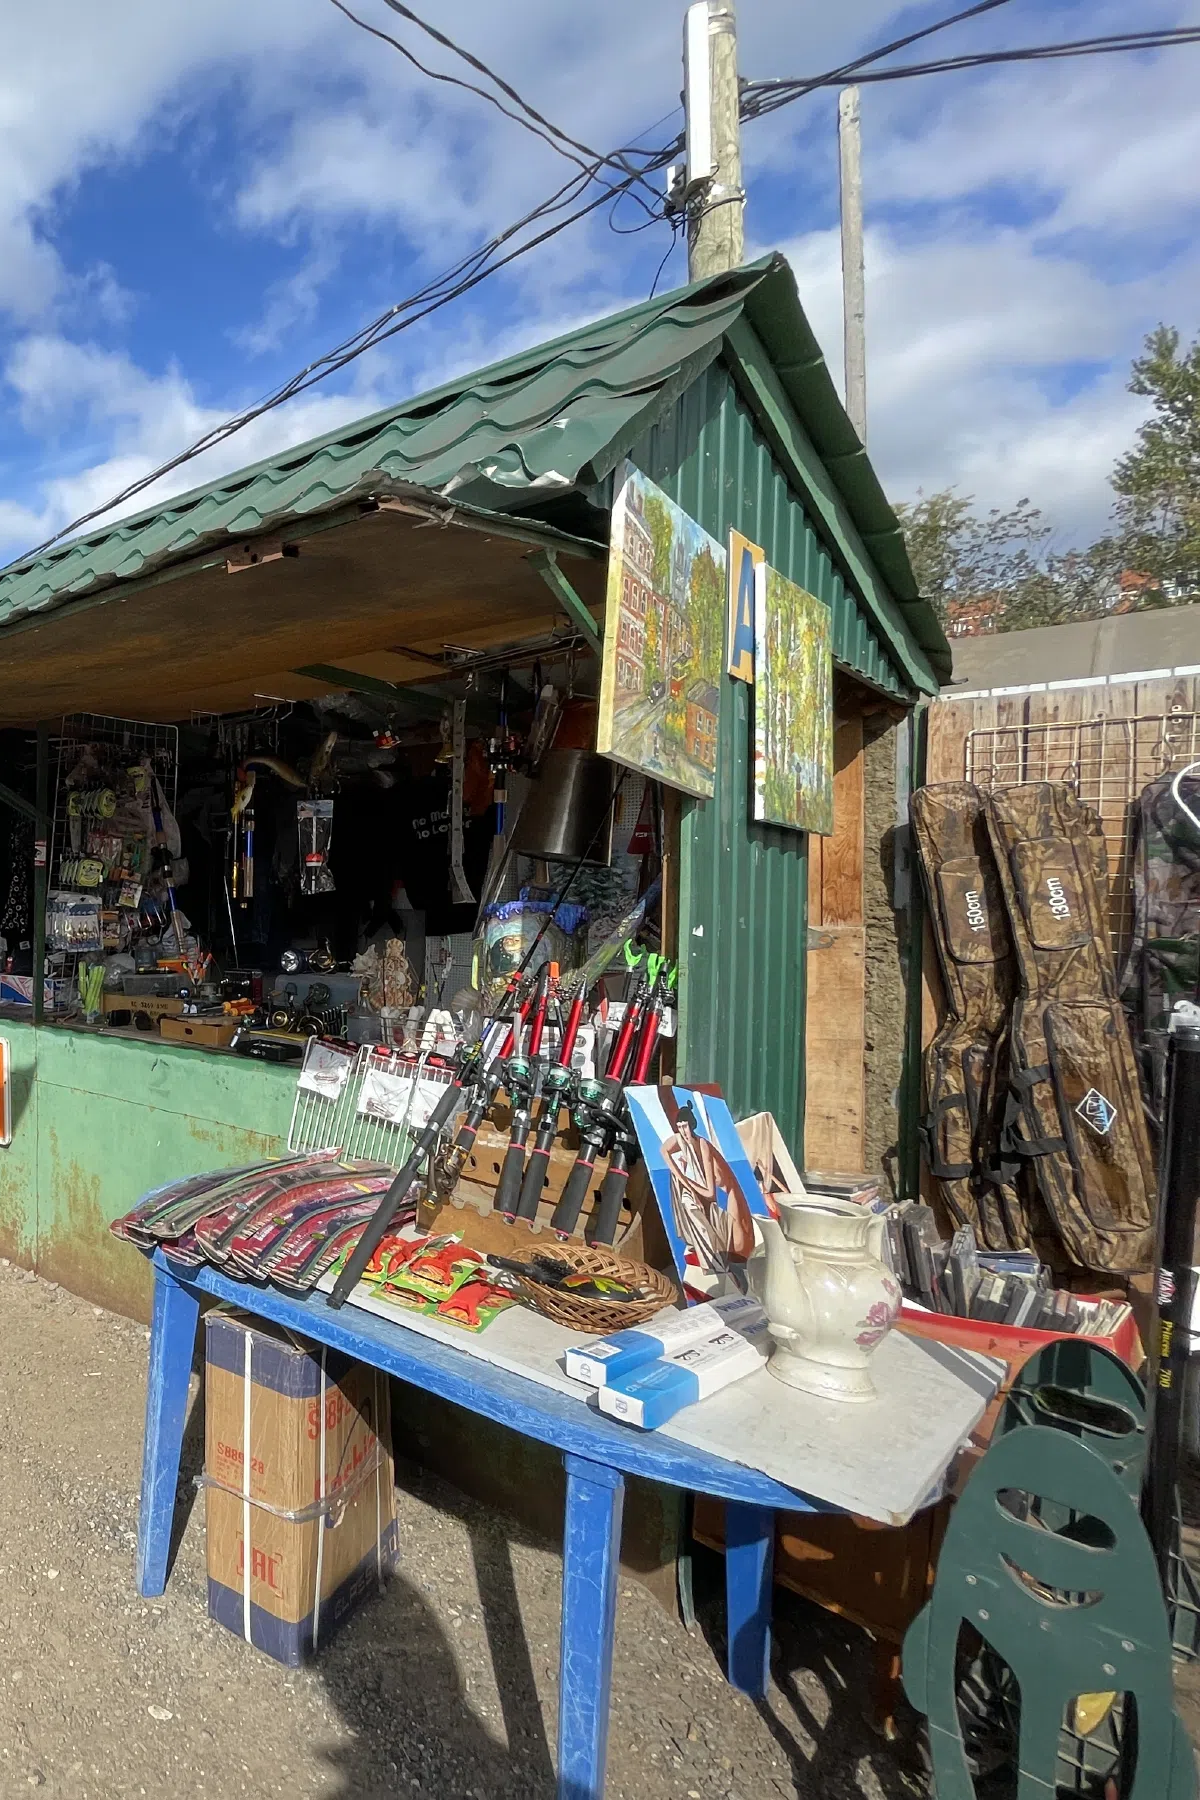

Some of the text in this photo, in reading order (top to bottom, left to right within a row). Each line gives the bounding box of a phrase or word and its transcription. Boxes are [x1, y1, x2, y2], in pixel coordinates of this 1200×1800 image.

[964, 890, 986, 932] 150cm
[1046, 877, 1071, 920] 130cm
[1157, 1267, 1175, 1304] MIKADO
[1159, 1368, 1173, 1389] 700
[216, 1441, 265, 1476] S88928
